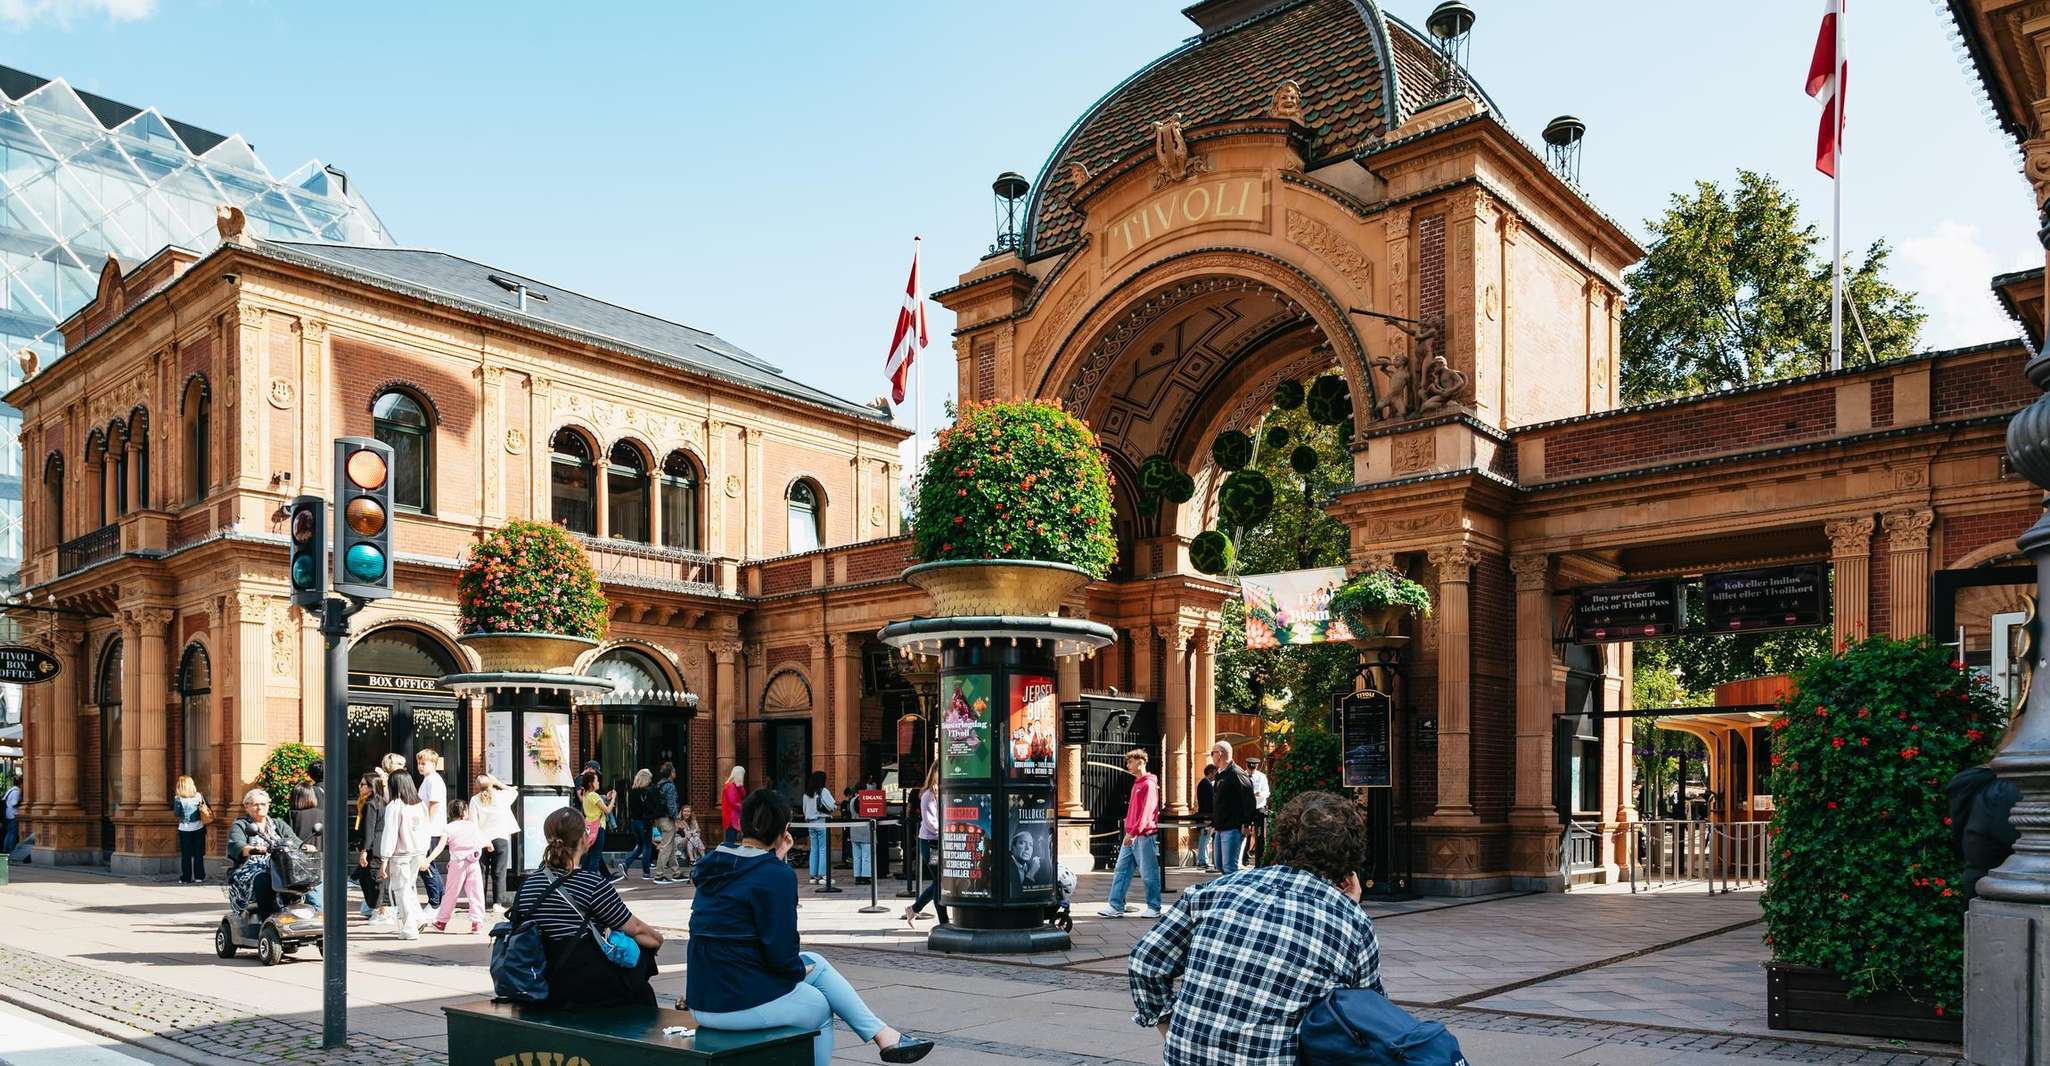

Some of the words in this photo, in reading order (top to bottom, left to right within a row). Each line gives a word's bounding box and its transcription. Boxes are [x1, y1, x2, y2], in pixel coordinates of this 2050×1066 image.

[1109, 181, 1256, 251] TIVOLI
[1746, 579, 1768, 588] eller
[1592, 594, 1609, 604] Buy
[1622, 591, 1656, 600] redeem
[1712, 591, 1738, 601] billet
[1739, 590, 1762, 599] eller
[1765, 584, 1814, 596] Tivolikort
[1580, 603, 1609, 613] tickets
[1621, 600, 1648, 609] Tivoli
[1649, 599, 1670, 607] Pass
[0, 652, 36, 661] TIVOLI
[6, 660, 28, 670] BOX
[0, 669, 37, 679] OFFICE
[368, 676, 394, 687] BOX
[395, 677, 436, 690] OFFICE
[1022, 684, 1053, 703] JERSEY
[1356, 691, 1375, 699] TIVOLI
[951, 728, 970, 737] Tivoli
